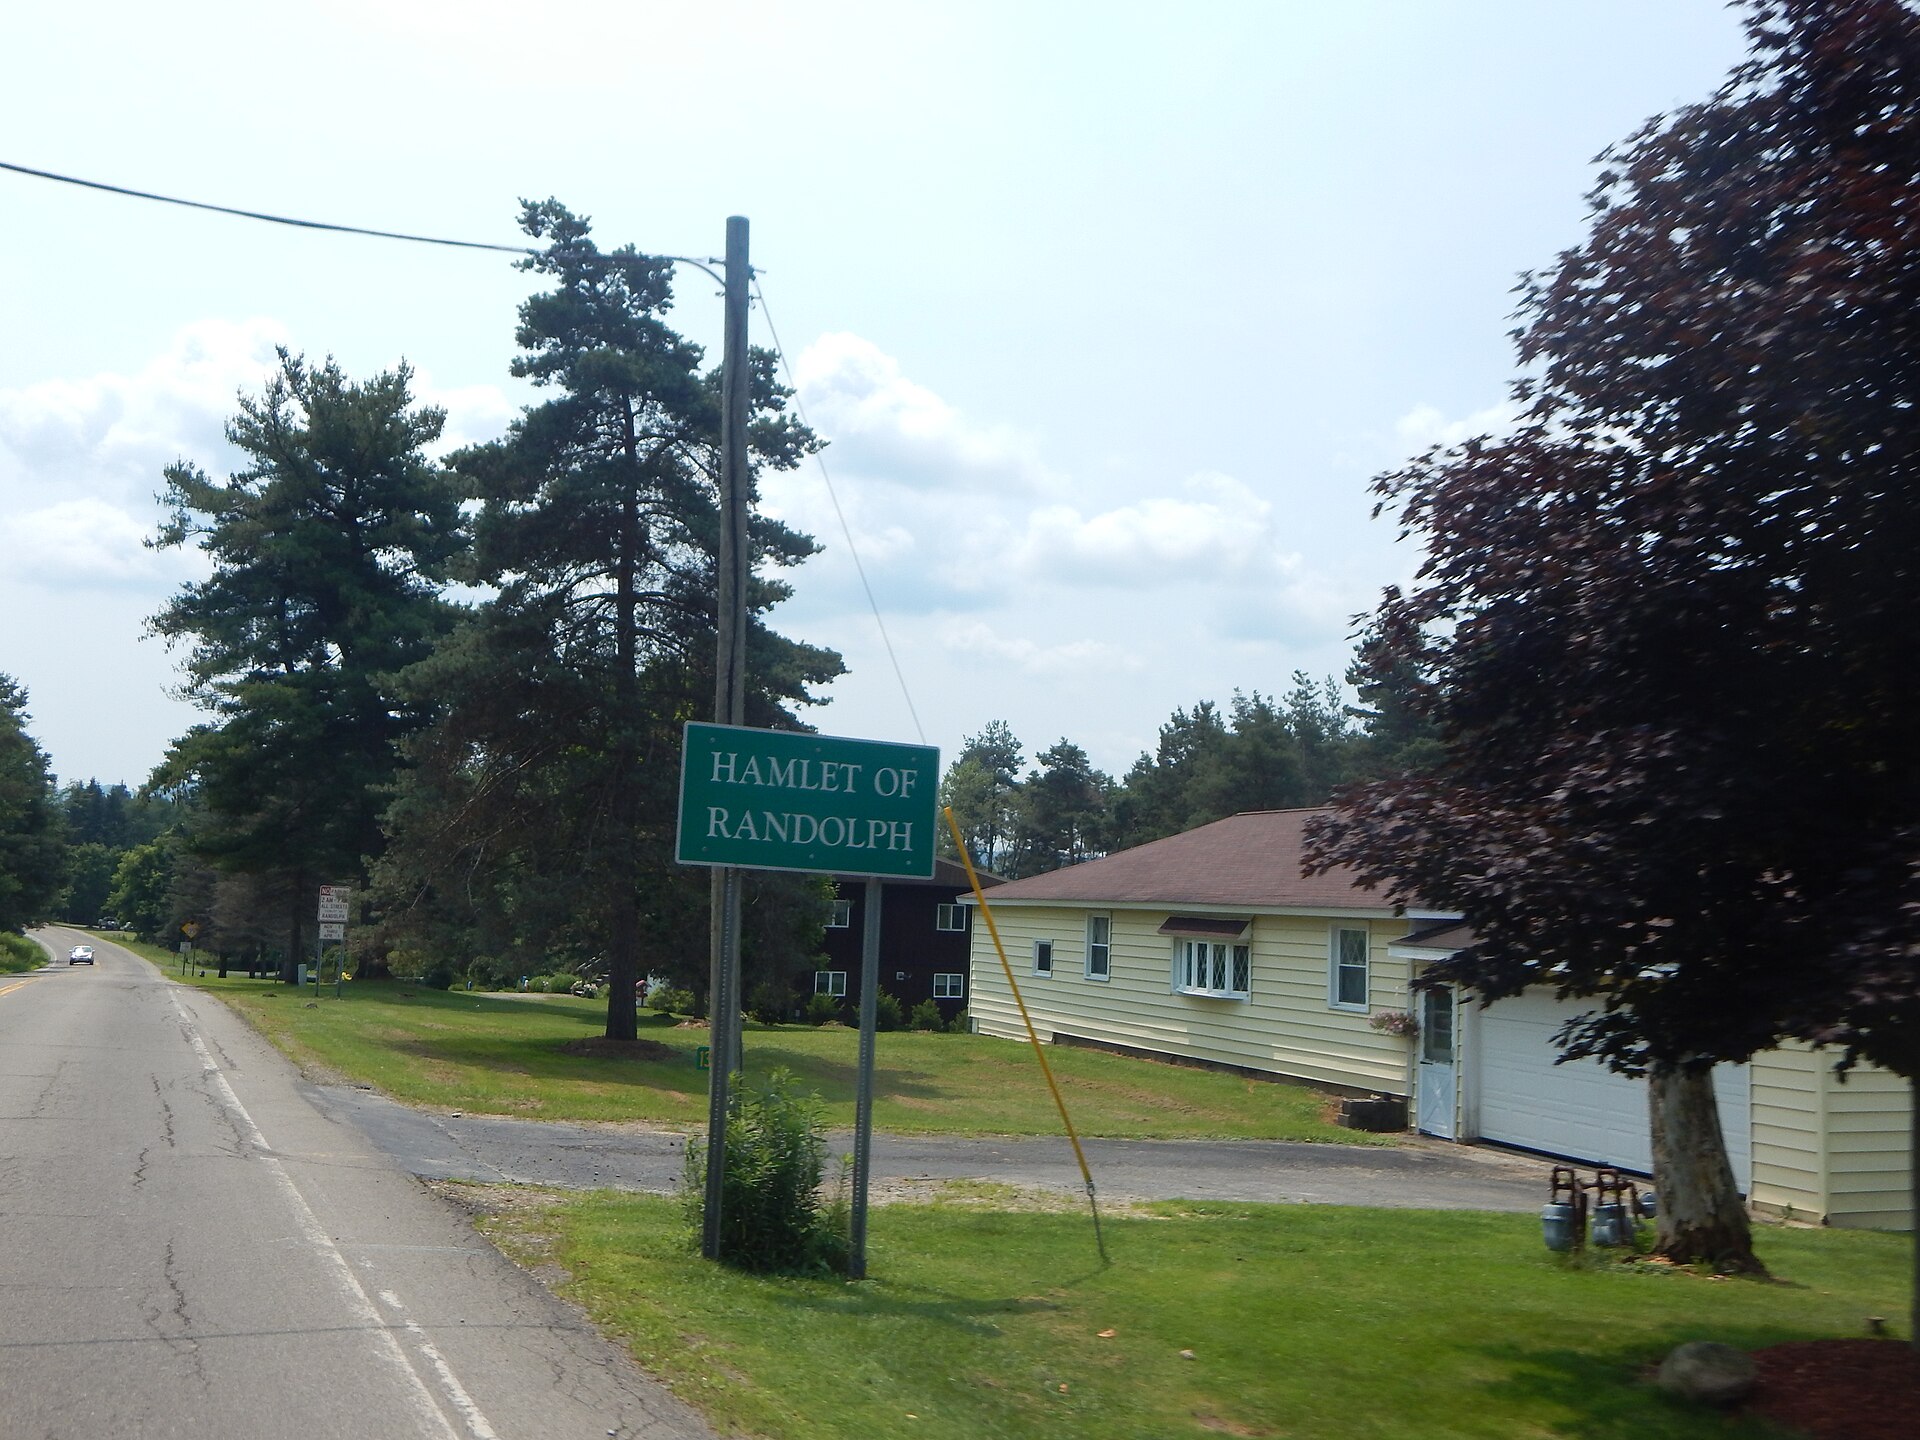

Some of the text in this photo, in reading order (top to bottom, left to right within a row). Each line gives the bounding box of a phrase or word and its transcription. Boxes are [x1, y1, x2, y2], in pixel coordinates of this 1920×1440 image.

[710, 751, 918, 798] HAMLET OF
[706, 806, 913, 851] RANDOLPH
[321, 887, 331, 895] NO
